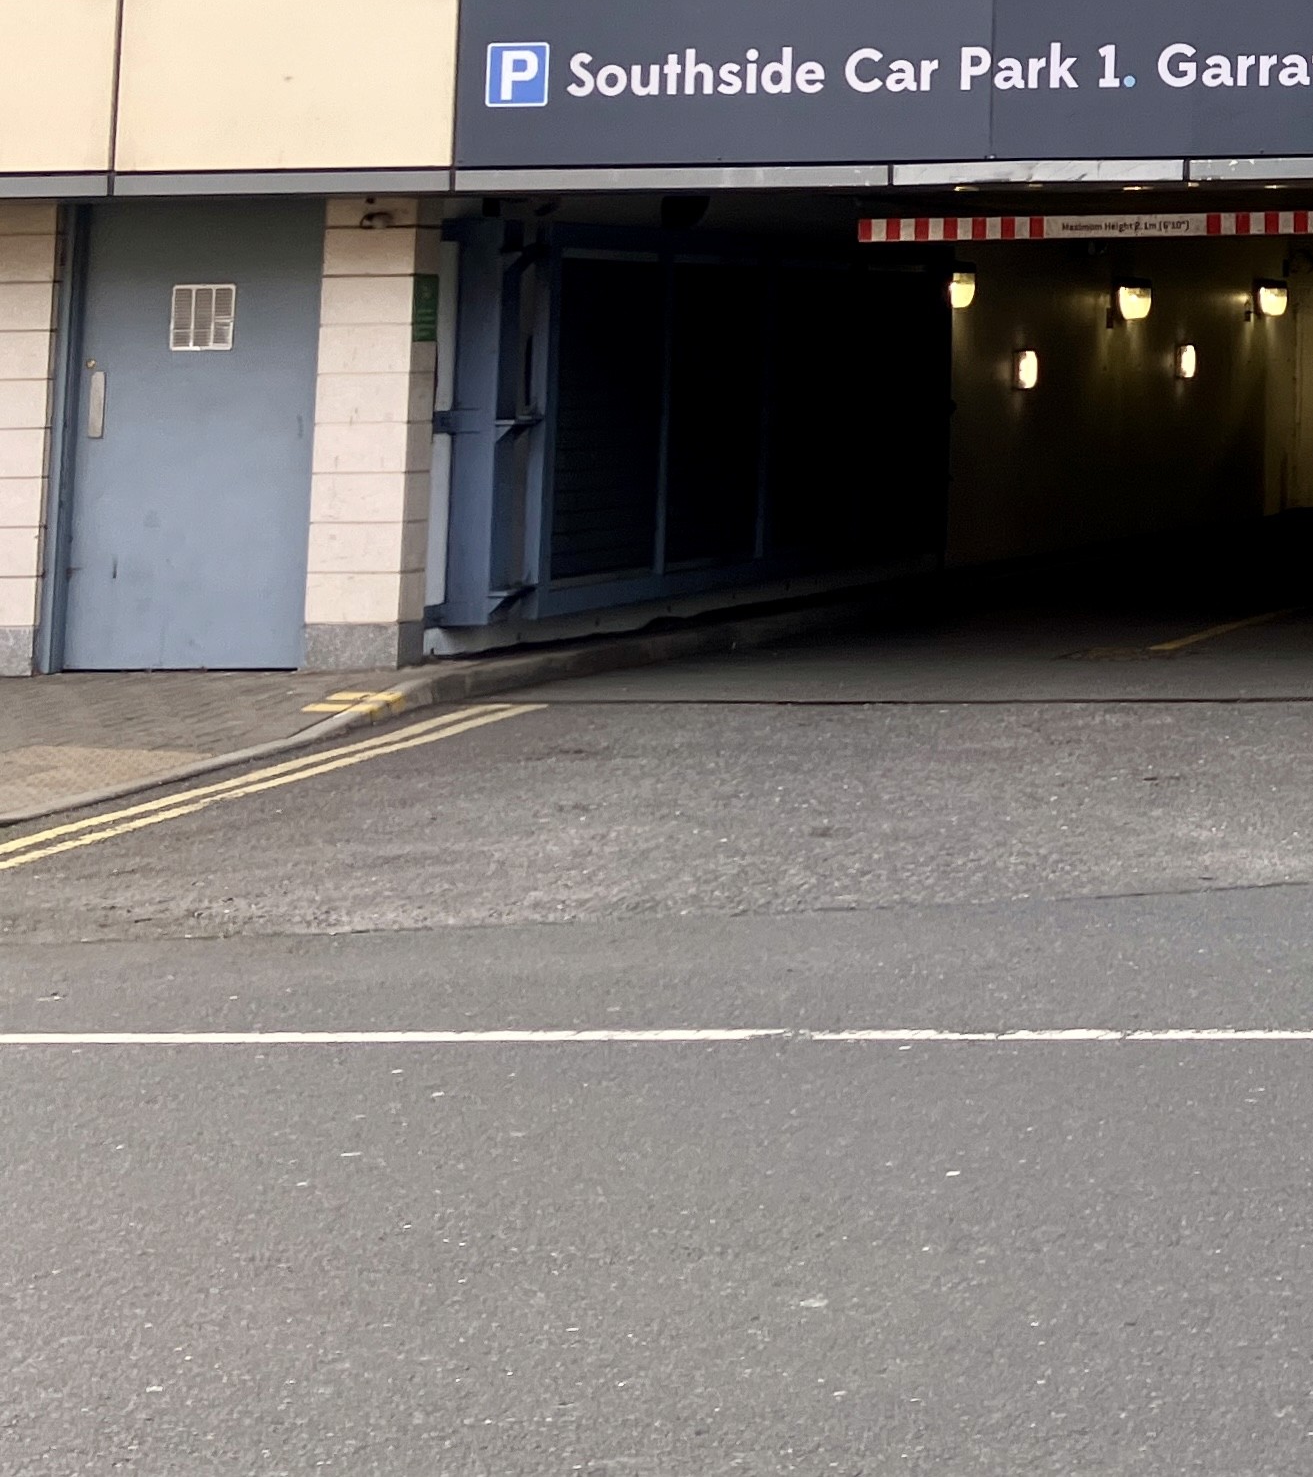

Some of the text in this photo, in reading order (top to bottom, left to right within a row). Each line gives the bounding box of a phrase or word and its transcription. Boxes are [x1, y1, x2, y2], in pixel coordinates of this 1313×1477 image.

[501, 50, 539, 101] P
[566, 47, 826, 98] Southside
[845, 46, 939, 94] Car
[960, 42, 1079, 91] Park
[1098, 43, 1136, 89] 1.
[1062, 222, 1103, 231] Maximum
[1104, 221, 1133, 233] Height
